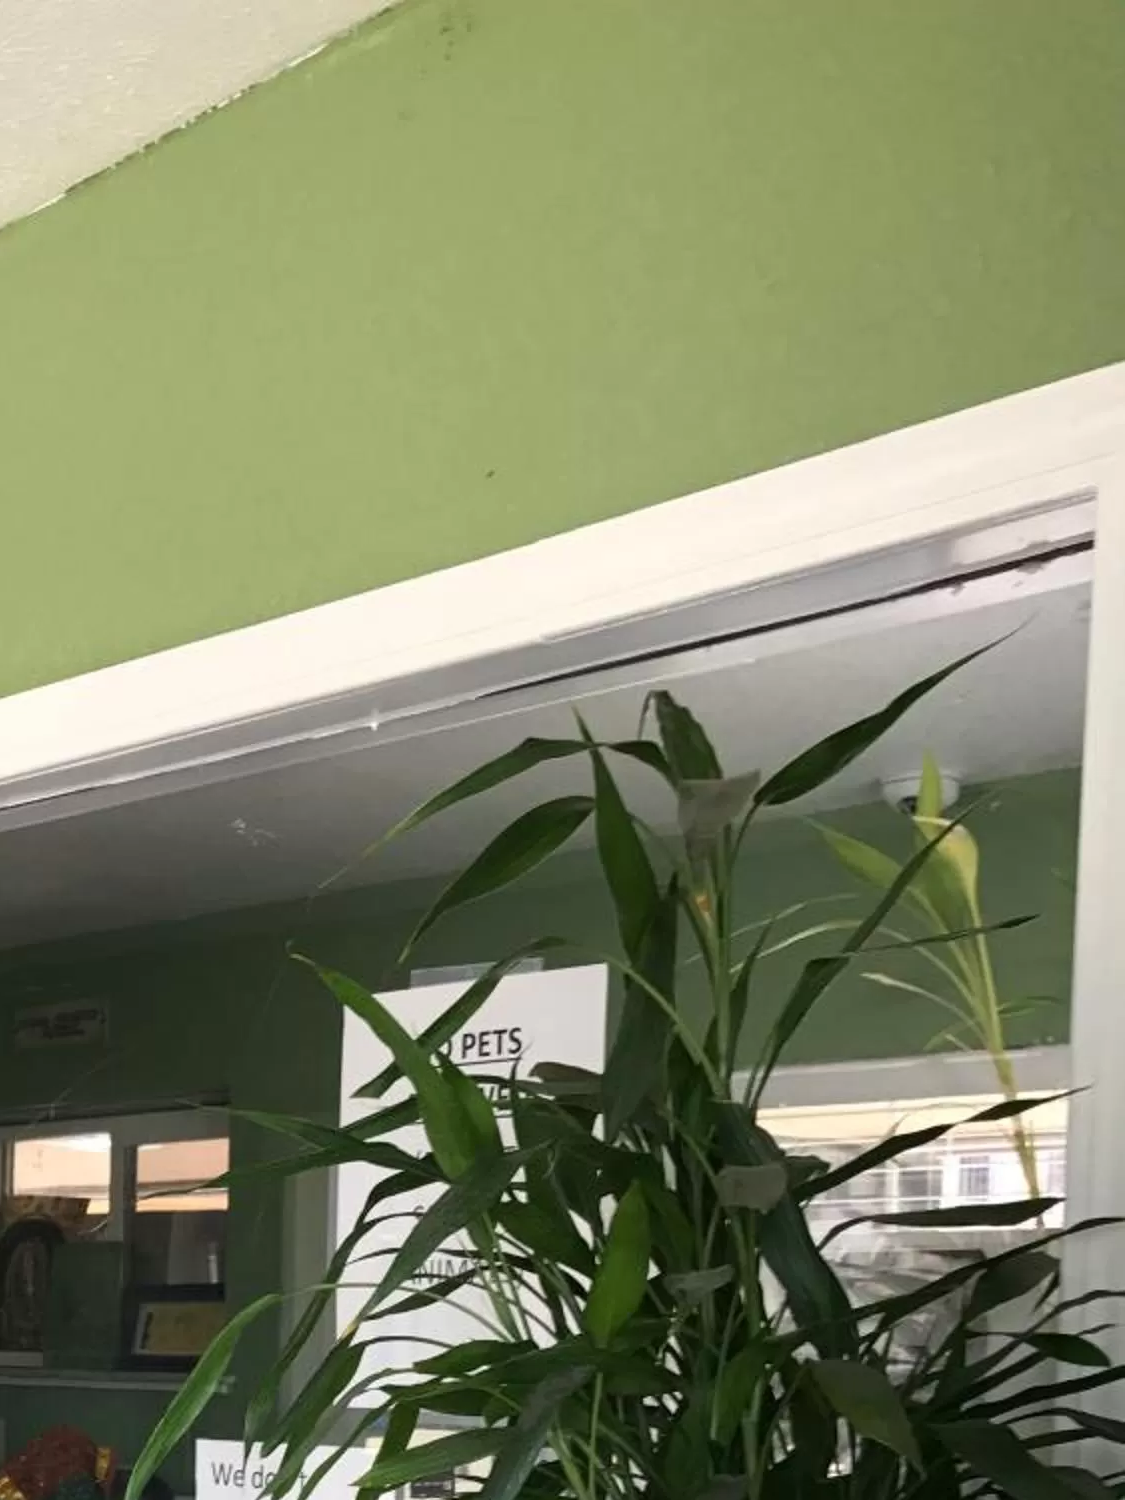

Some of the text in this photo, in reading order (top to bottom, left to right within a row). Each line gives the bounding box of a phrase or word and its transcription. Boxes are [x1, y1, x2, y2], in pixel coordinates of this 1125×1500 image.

[461, 1027, 523, 1059] PETS
[211, 1461, 308, 1491] We dot
